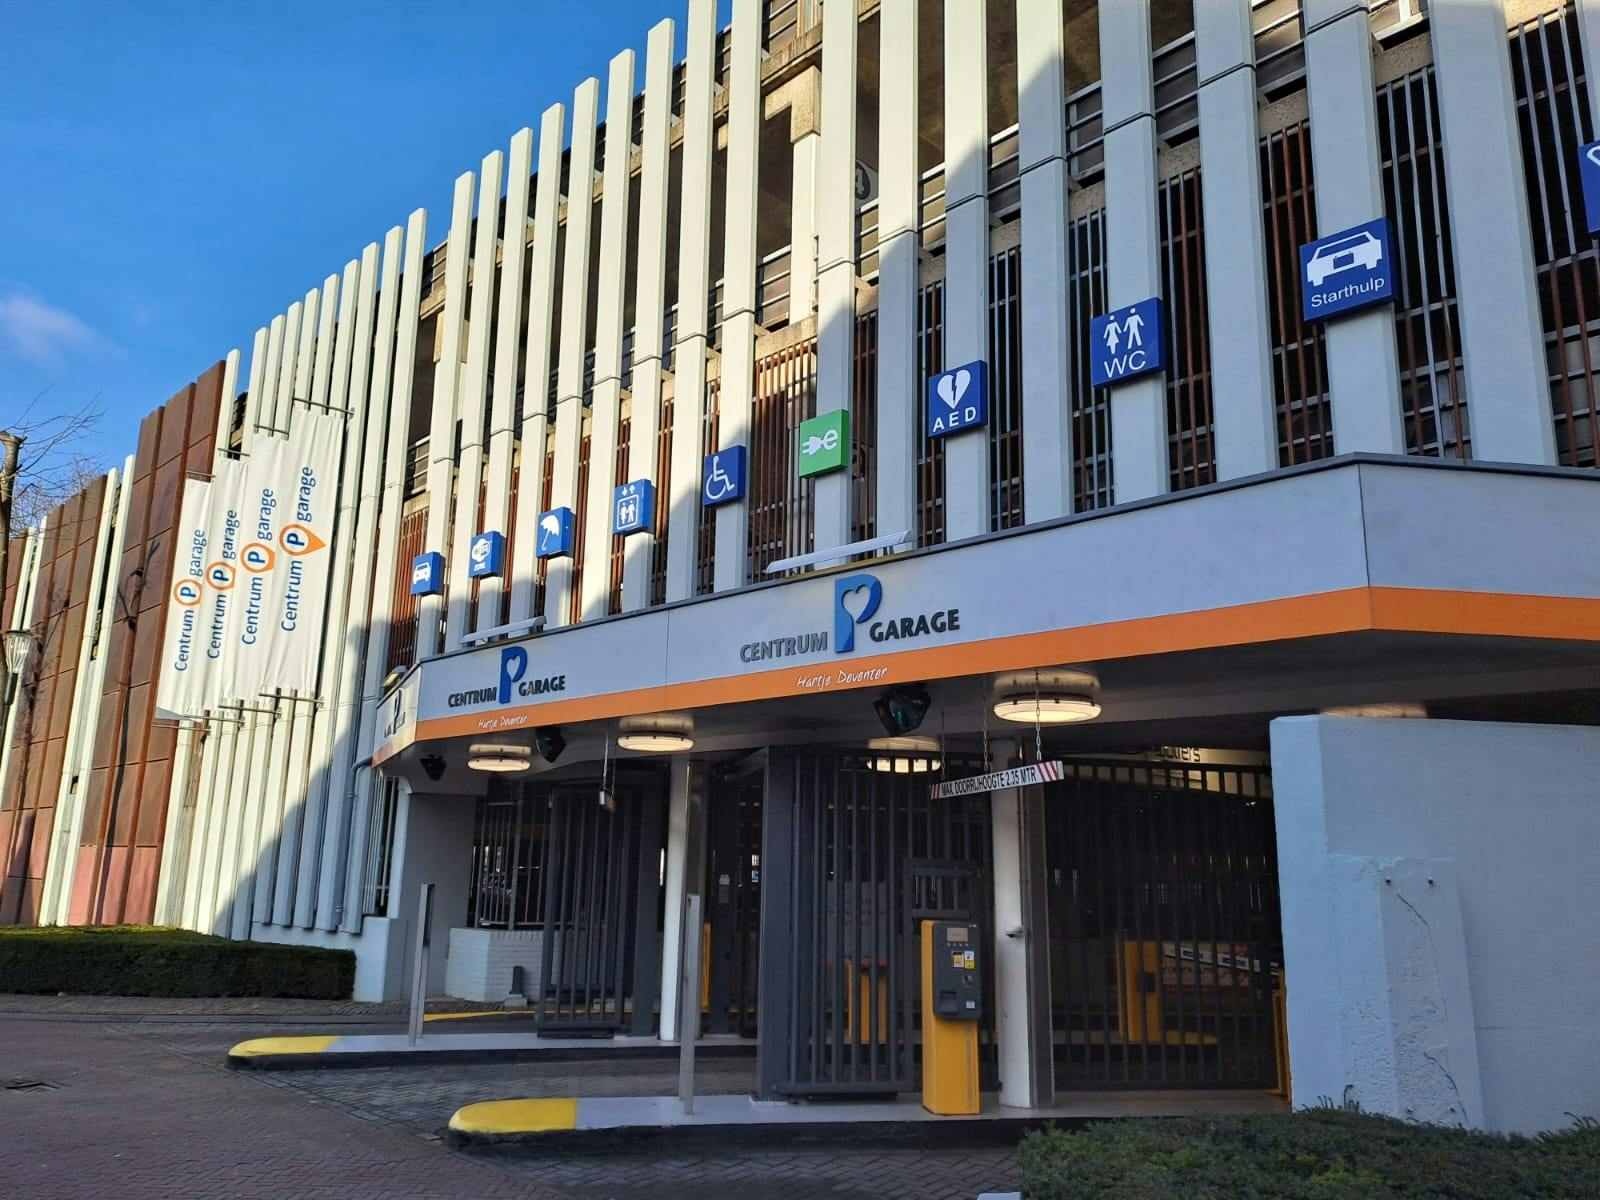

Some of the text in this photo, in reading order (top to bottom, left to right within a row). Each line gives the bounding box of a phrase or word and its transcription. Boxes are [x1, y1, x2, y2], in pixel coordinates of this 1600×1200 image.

[1311, 276, 1385, 307] Starthulp
[1103, 350, 1146, 378] WC
[932, 406, 977, 432] AED
[281, 466, 315, 632] Centrum P garage
[241, 488, 277, 645] Centrum P garage
[174, 529, 207, 672] Centrum P garage
[207, 509, 238, 660] Centrum P garage
[740, 631, 828, 663] CENTRUM
[869, 608, 960, 642] GARAGE
[448, 687, 497, 708] CENTRUM
[518, 675, 566, 697] GARAGE
[797, 667, 888, 690] Hartje Deventer
[1006, 770, 1019, 787] 2.35
[1020, 767, 1037, 784] MTR
